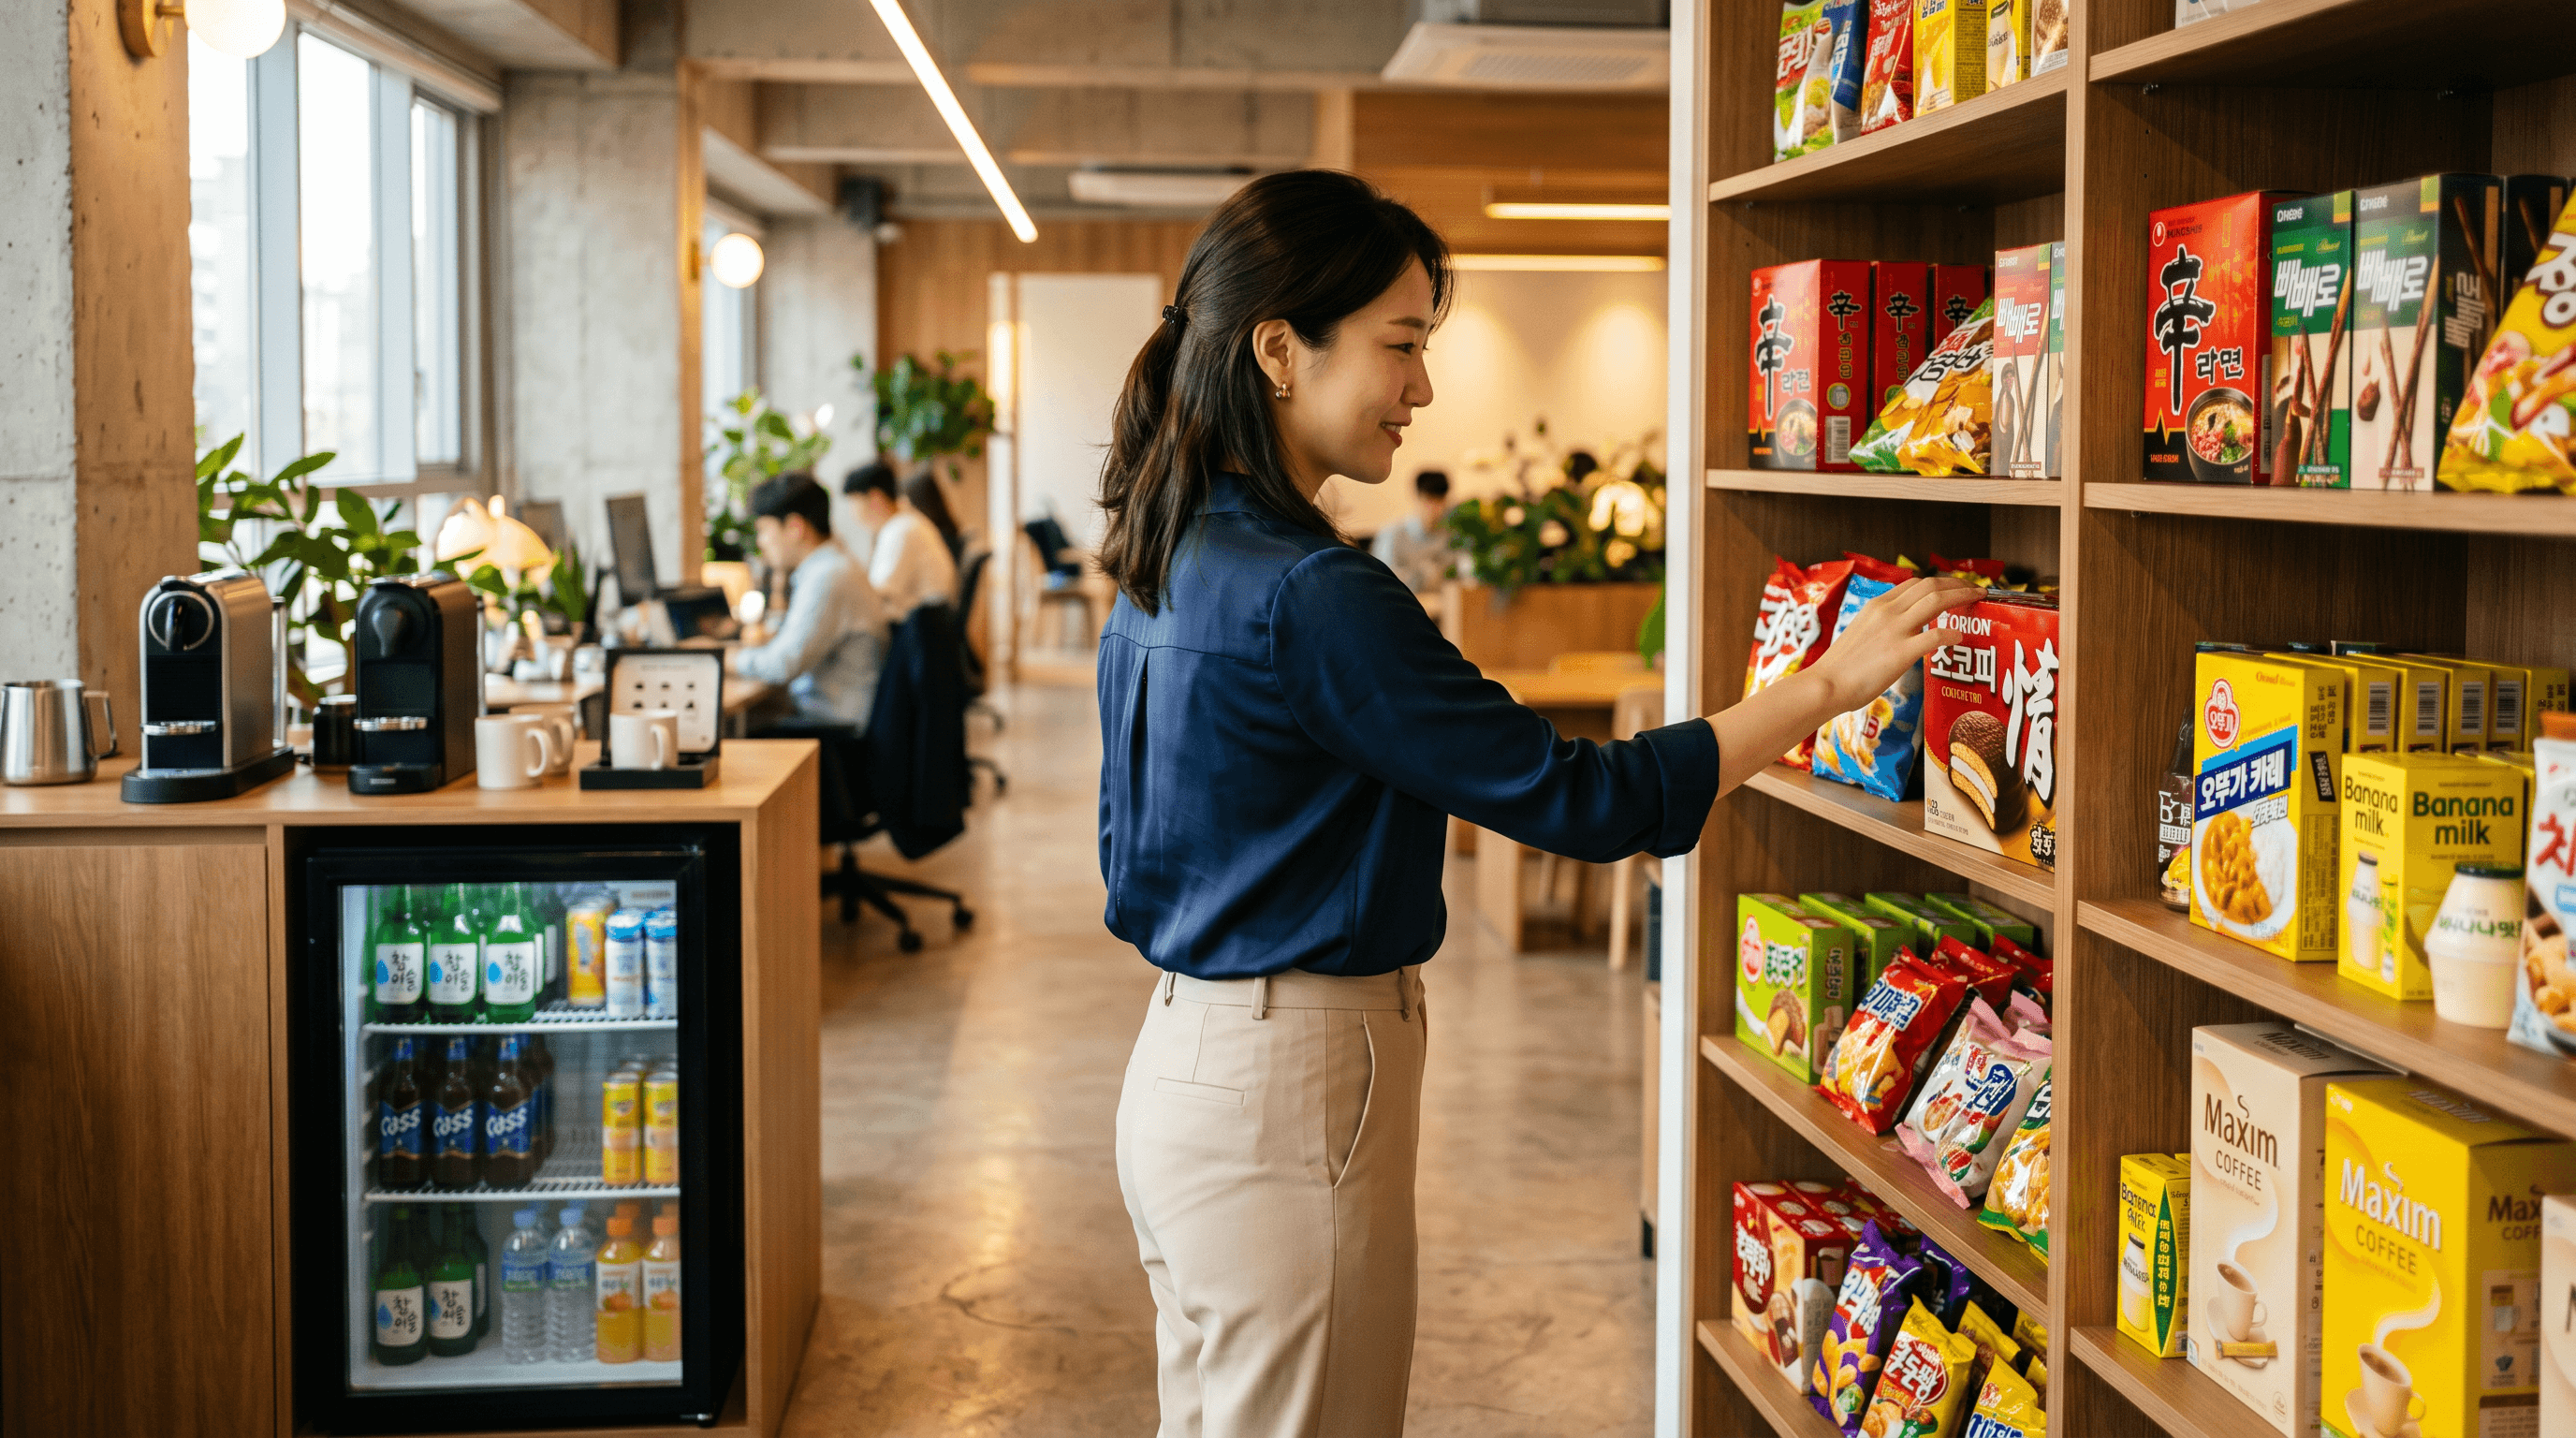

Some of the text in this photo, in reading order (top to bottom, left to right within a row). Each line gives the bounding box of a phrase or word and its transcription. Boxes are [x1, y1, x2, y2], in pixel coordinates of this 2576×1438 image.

[2274, 258, 2341, 317] 빼빼로
[2356, 249, 2428, 312] 빼빼로
[1996, 297, 2042, 344] 빼빼로
[2154, 243, 2217, 416] 辛
[1755, 293, 1794, 420] 辛
[2195, 345, 2245, 385] 라면
[1950, 614, 1992, 637] ORION
[2249, 748, 2286, 793] 카레
[2344, 775, 2398, 814] Banana
[2412, 791, 2514, 817] Banana
[2354, 809, 2385, 837] milk
[2435, 818, 2490, 844] milk
[2204, 1093, 2278, 1168] Maxim
[2216, 1150, 2262, 1192] COFFEE
[2340, 1157, 2442, 1251] Maxim
[2487, 1194, 2542, 1223] Max
[2355, 1224, 2418, 1276] COFFEE
[2501, 1225, 2542, 1242] COFF
